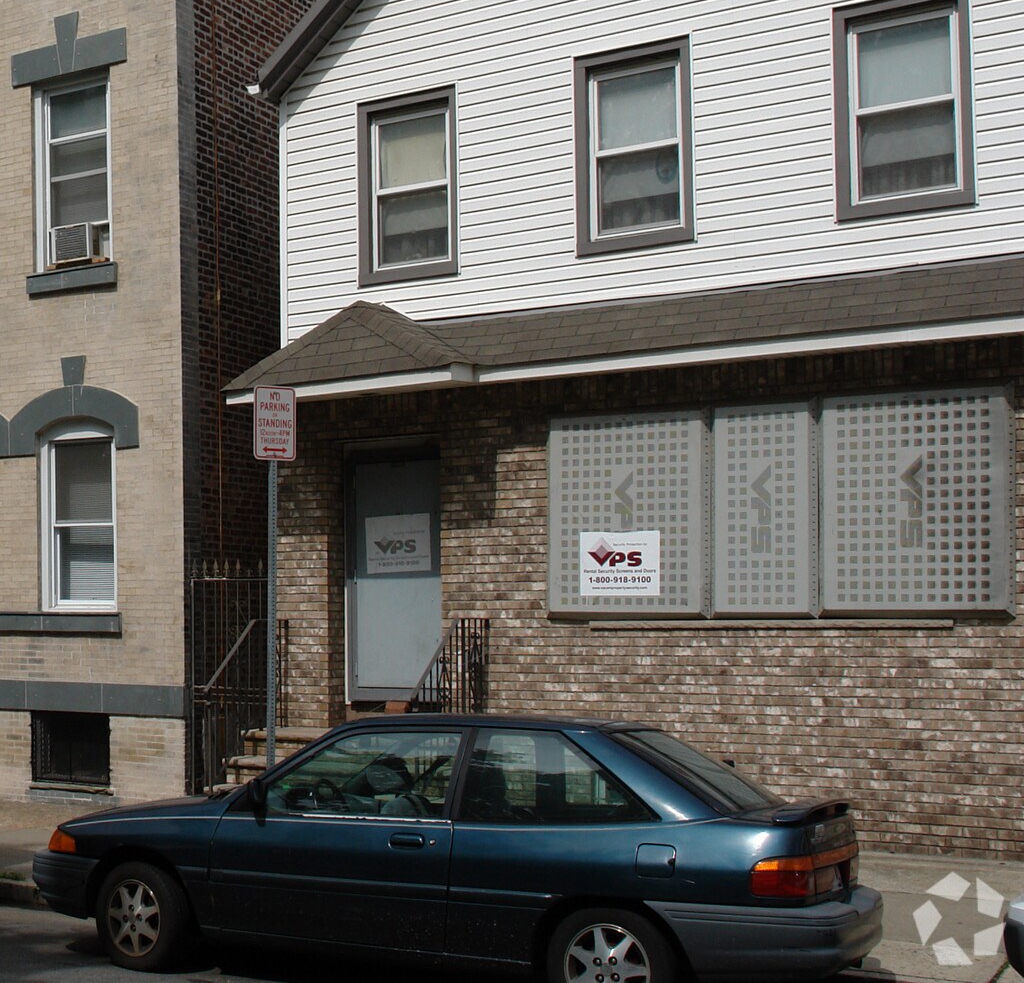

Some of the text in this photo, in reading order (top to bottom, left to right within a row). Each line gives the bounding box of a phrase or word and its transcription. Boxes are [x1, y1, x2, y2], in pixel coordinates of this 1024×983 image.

[269, 392, 281, 401] NO
[259, 402, 290, 413] PARKING
[258, 418, 293, 429] STANDING
[260, 437, 289, 445] THURSDAY
[614, 470, 634, 530] VP
[900, 453, 923, 548] VPS
[750, 464, 772, 554] VPS
[373, 539, 417, 555] VPS
[587, 550, 643, 567] VPS
[588, 576, 652, 584] 1-800-918-9100
